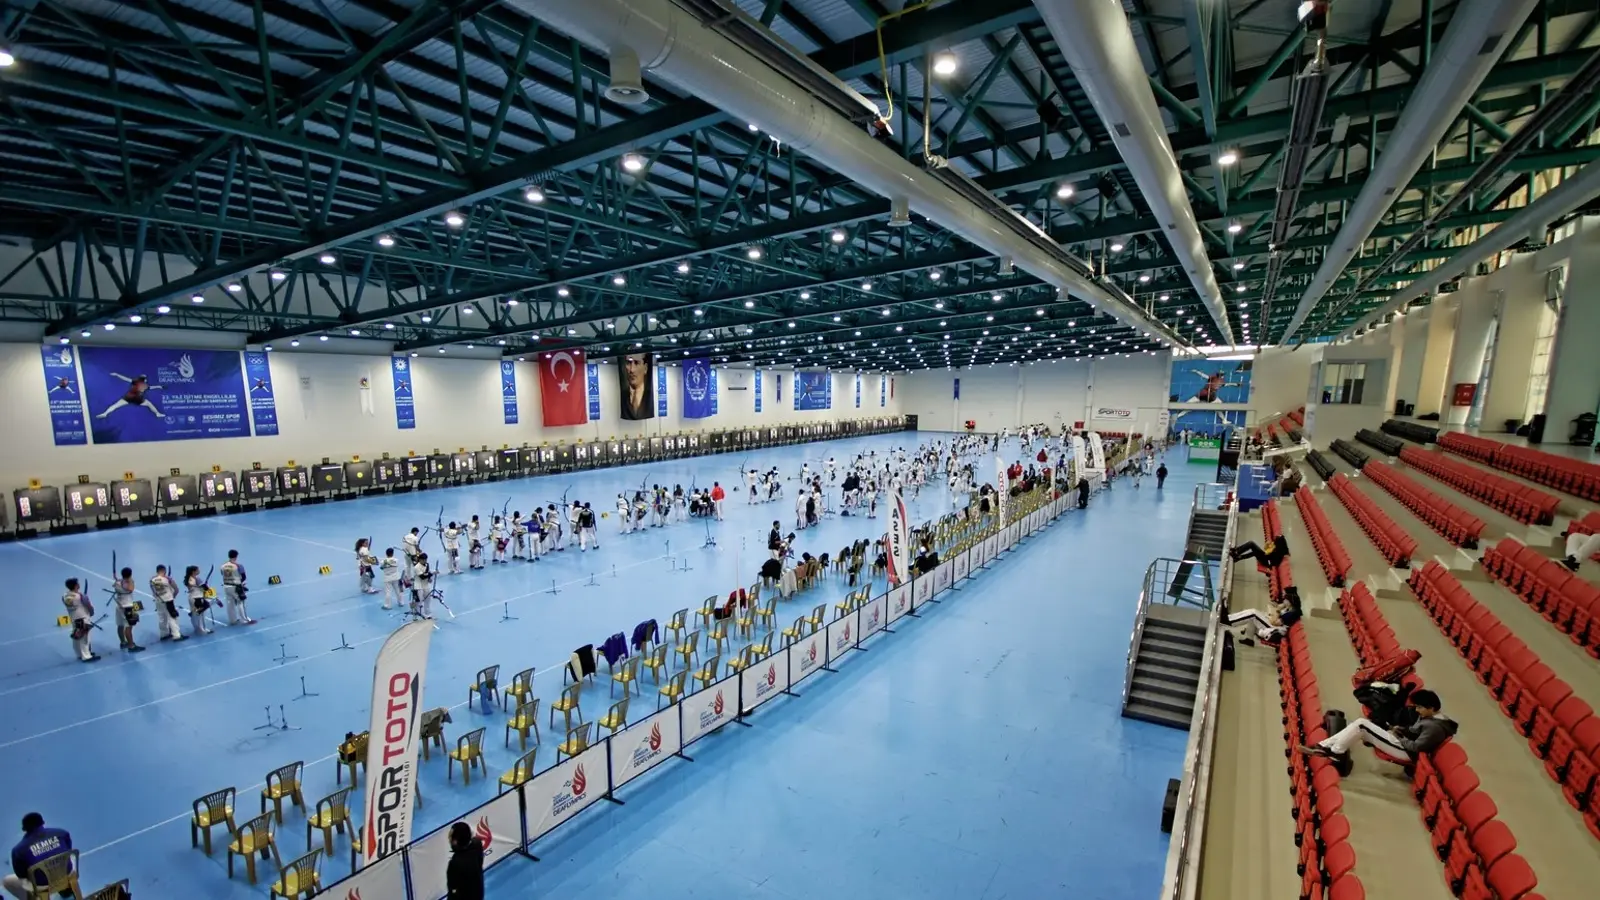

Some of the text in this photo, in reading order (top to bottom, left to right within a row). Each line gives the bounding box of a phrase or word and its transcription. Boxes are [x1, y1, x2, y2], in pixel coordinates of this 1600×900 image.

[377, 672, 411, 859] SPORTOTO
[552, 791, 587, 817] DEAFLYMPICS
[30, 836, 60, 851] DEMKA
